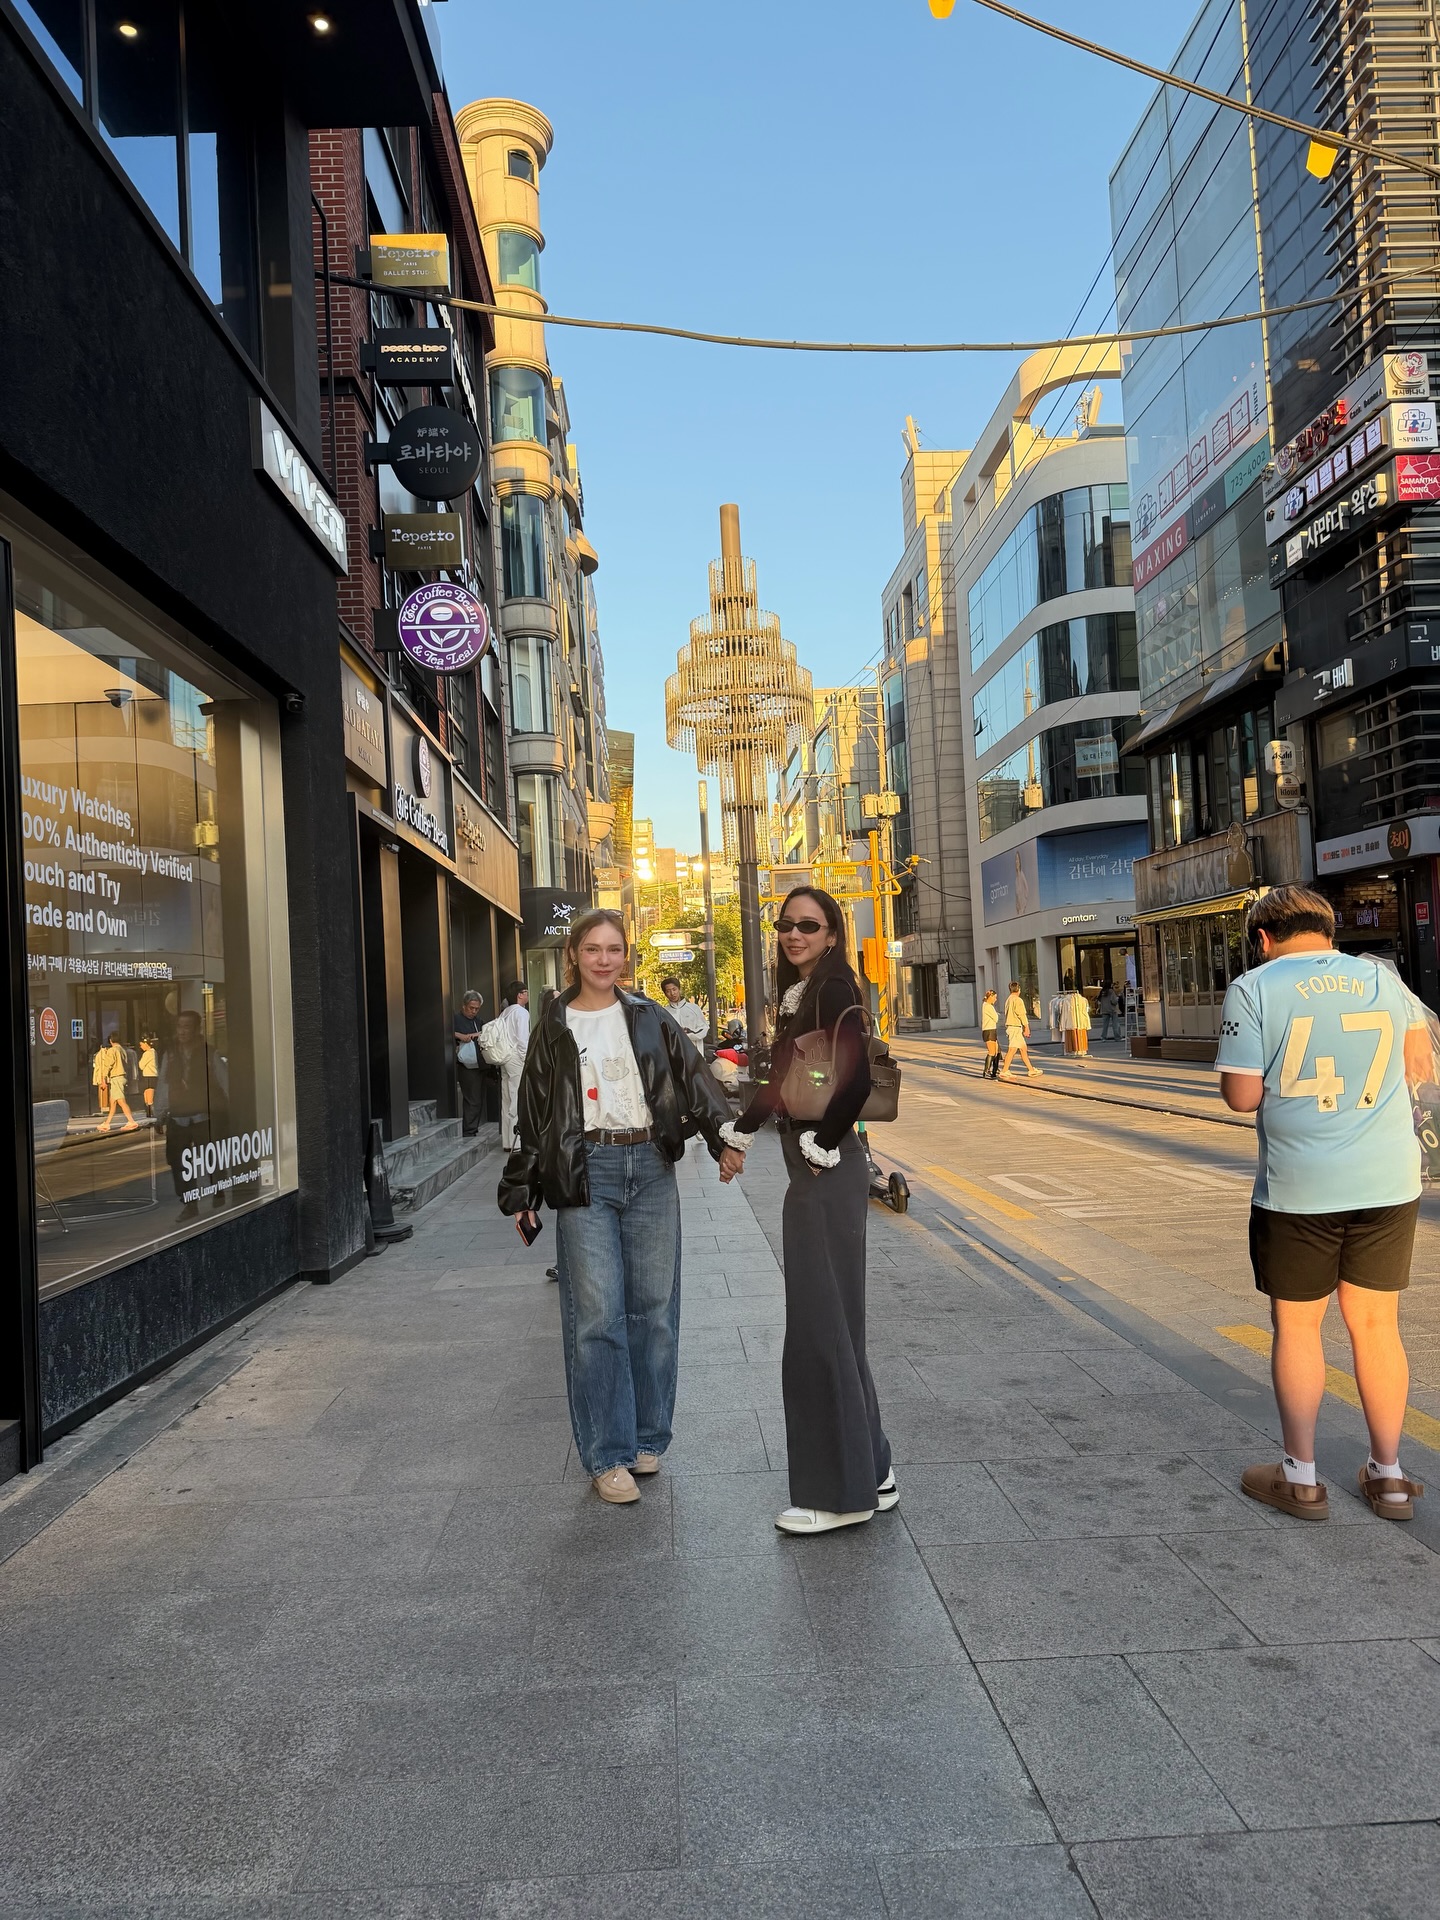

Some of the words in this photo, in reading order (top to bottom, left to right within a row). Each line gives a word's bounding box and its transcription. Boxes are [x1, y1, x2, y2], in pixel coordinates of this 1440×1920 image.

[396, 442, 472, 462] 로바타야
[1230, 450, 1267, 494] 723-4002
[1306, 502, 1347, 550] 사만다
[1350, 474, 1387, 515] 왁싱
[392, 528, 454, 545] repetto
[1135, 526, 1182, 583] WAXING
[402, 603, 418, 622] The
[416, 586, 452, 604] Coffee
[454, 590, 478, 622] Bean
[412, 645, 423, 656] &
[424, 650, 444, 665] Tea
[446, 641, 474, 664] Leaf
[1272, 751, 1292, 760] Asahi
[21, 774, 67, 814] uxury
[71, 787, 134, 838] Watches,
[395, 782, 409, 821] The
[409, 794, 432, 839] Coffee
[430, 814, 449, 857] Bean
[22, 812, 60, 847] 00%
[65, 825, 148, 875] Authenticity
[150, 851, 193, 882] Verified
[24, 860, 64, 888] ouch
[68, 871, 95, 895] and
[98, 872, 121, 905] Try
[1069, 863, 1106, 880] 감탄에
[1167, 851, 1224, 901] STACKE
[990, 884, 1008, 904] gamtan
[26, 902, 62, 928] rade
[66, 909, 93, 933] and
[97, 910, 127, 937] Own
[48, 956, 62, 972] 구매
[68, 958, 99, 975] 착용&상담
[1294, 974, 1365, 1000] FODEN
[44, 1020, 55, 1029] TAX
[1279, 1010, 1395, 1113] 47
[182, 1127, 272, 1182] SHOWROOM
[201, 1183, 218, 1197] Luxury
[218, 1177, 232, 1190] Watch
[232, 1172, 249, 1185] Trading
[249, 1170, 258, 1182] App
